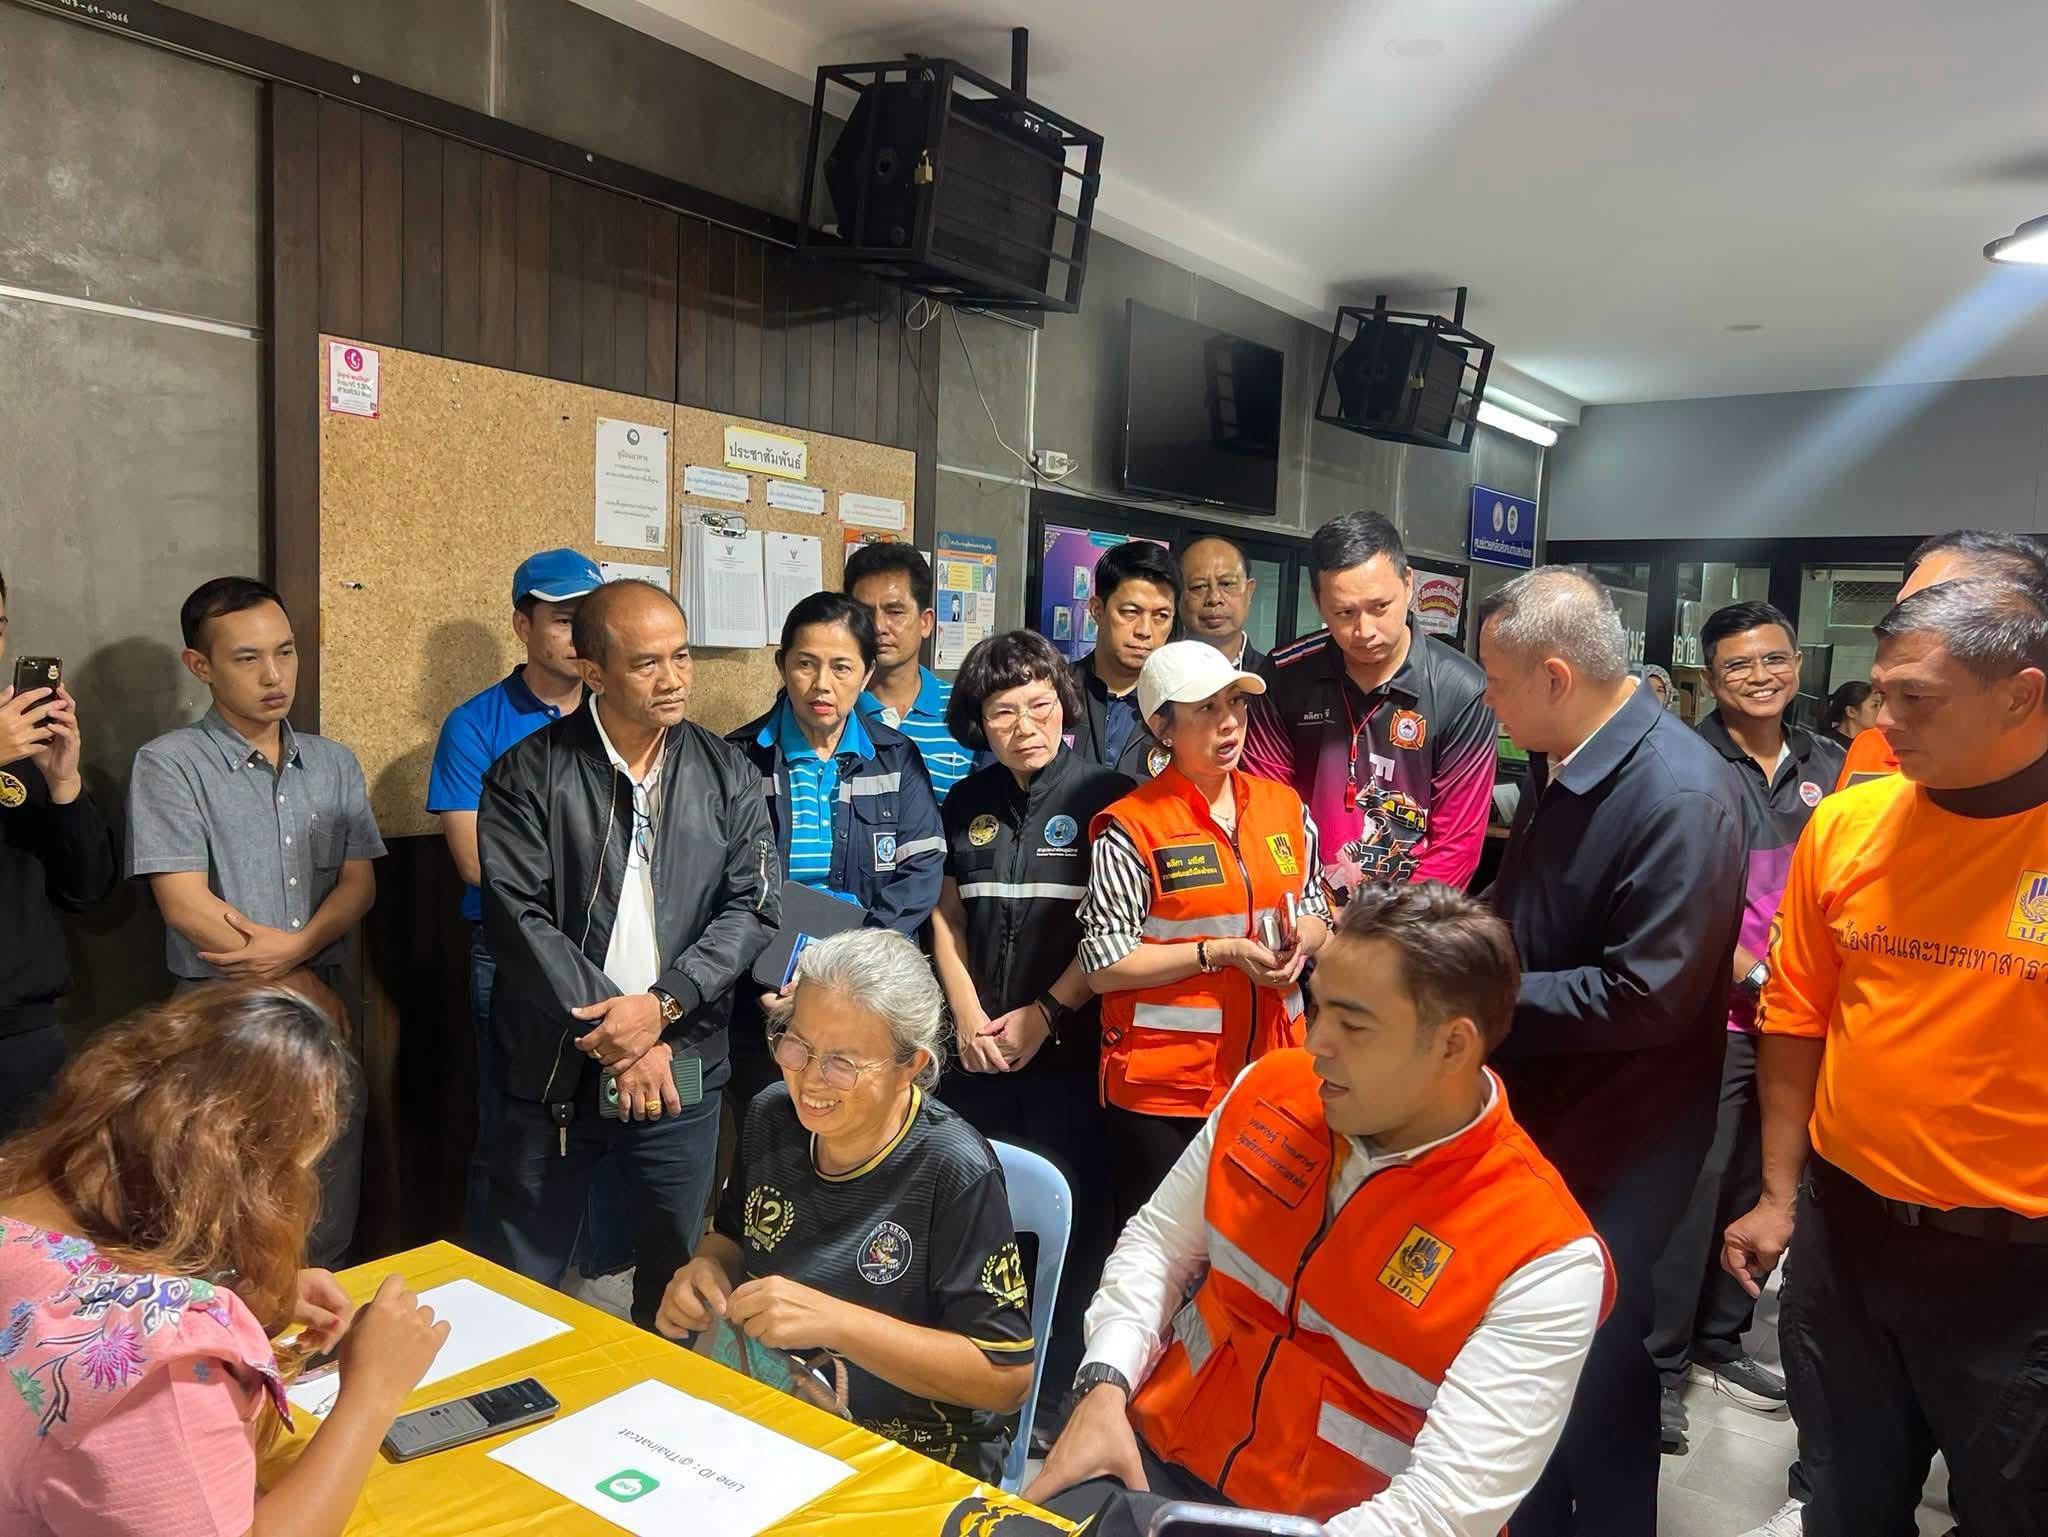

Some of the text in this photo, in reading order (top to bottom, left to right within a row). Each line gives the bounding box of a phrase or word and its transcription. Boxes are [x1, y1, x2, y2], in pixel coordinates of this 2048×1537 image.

[729, 441, 801, 469] ประชาสัมพันธ์
[699, 1468, 715, 1479] ID
[615, 1481, 637, 1492] LINE
[716, 1475, 745, 1492] Line
